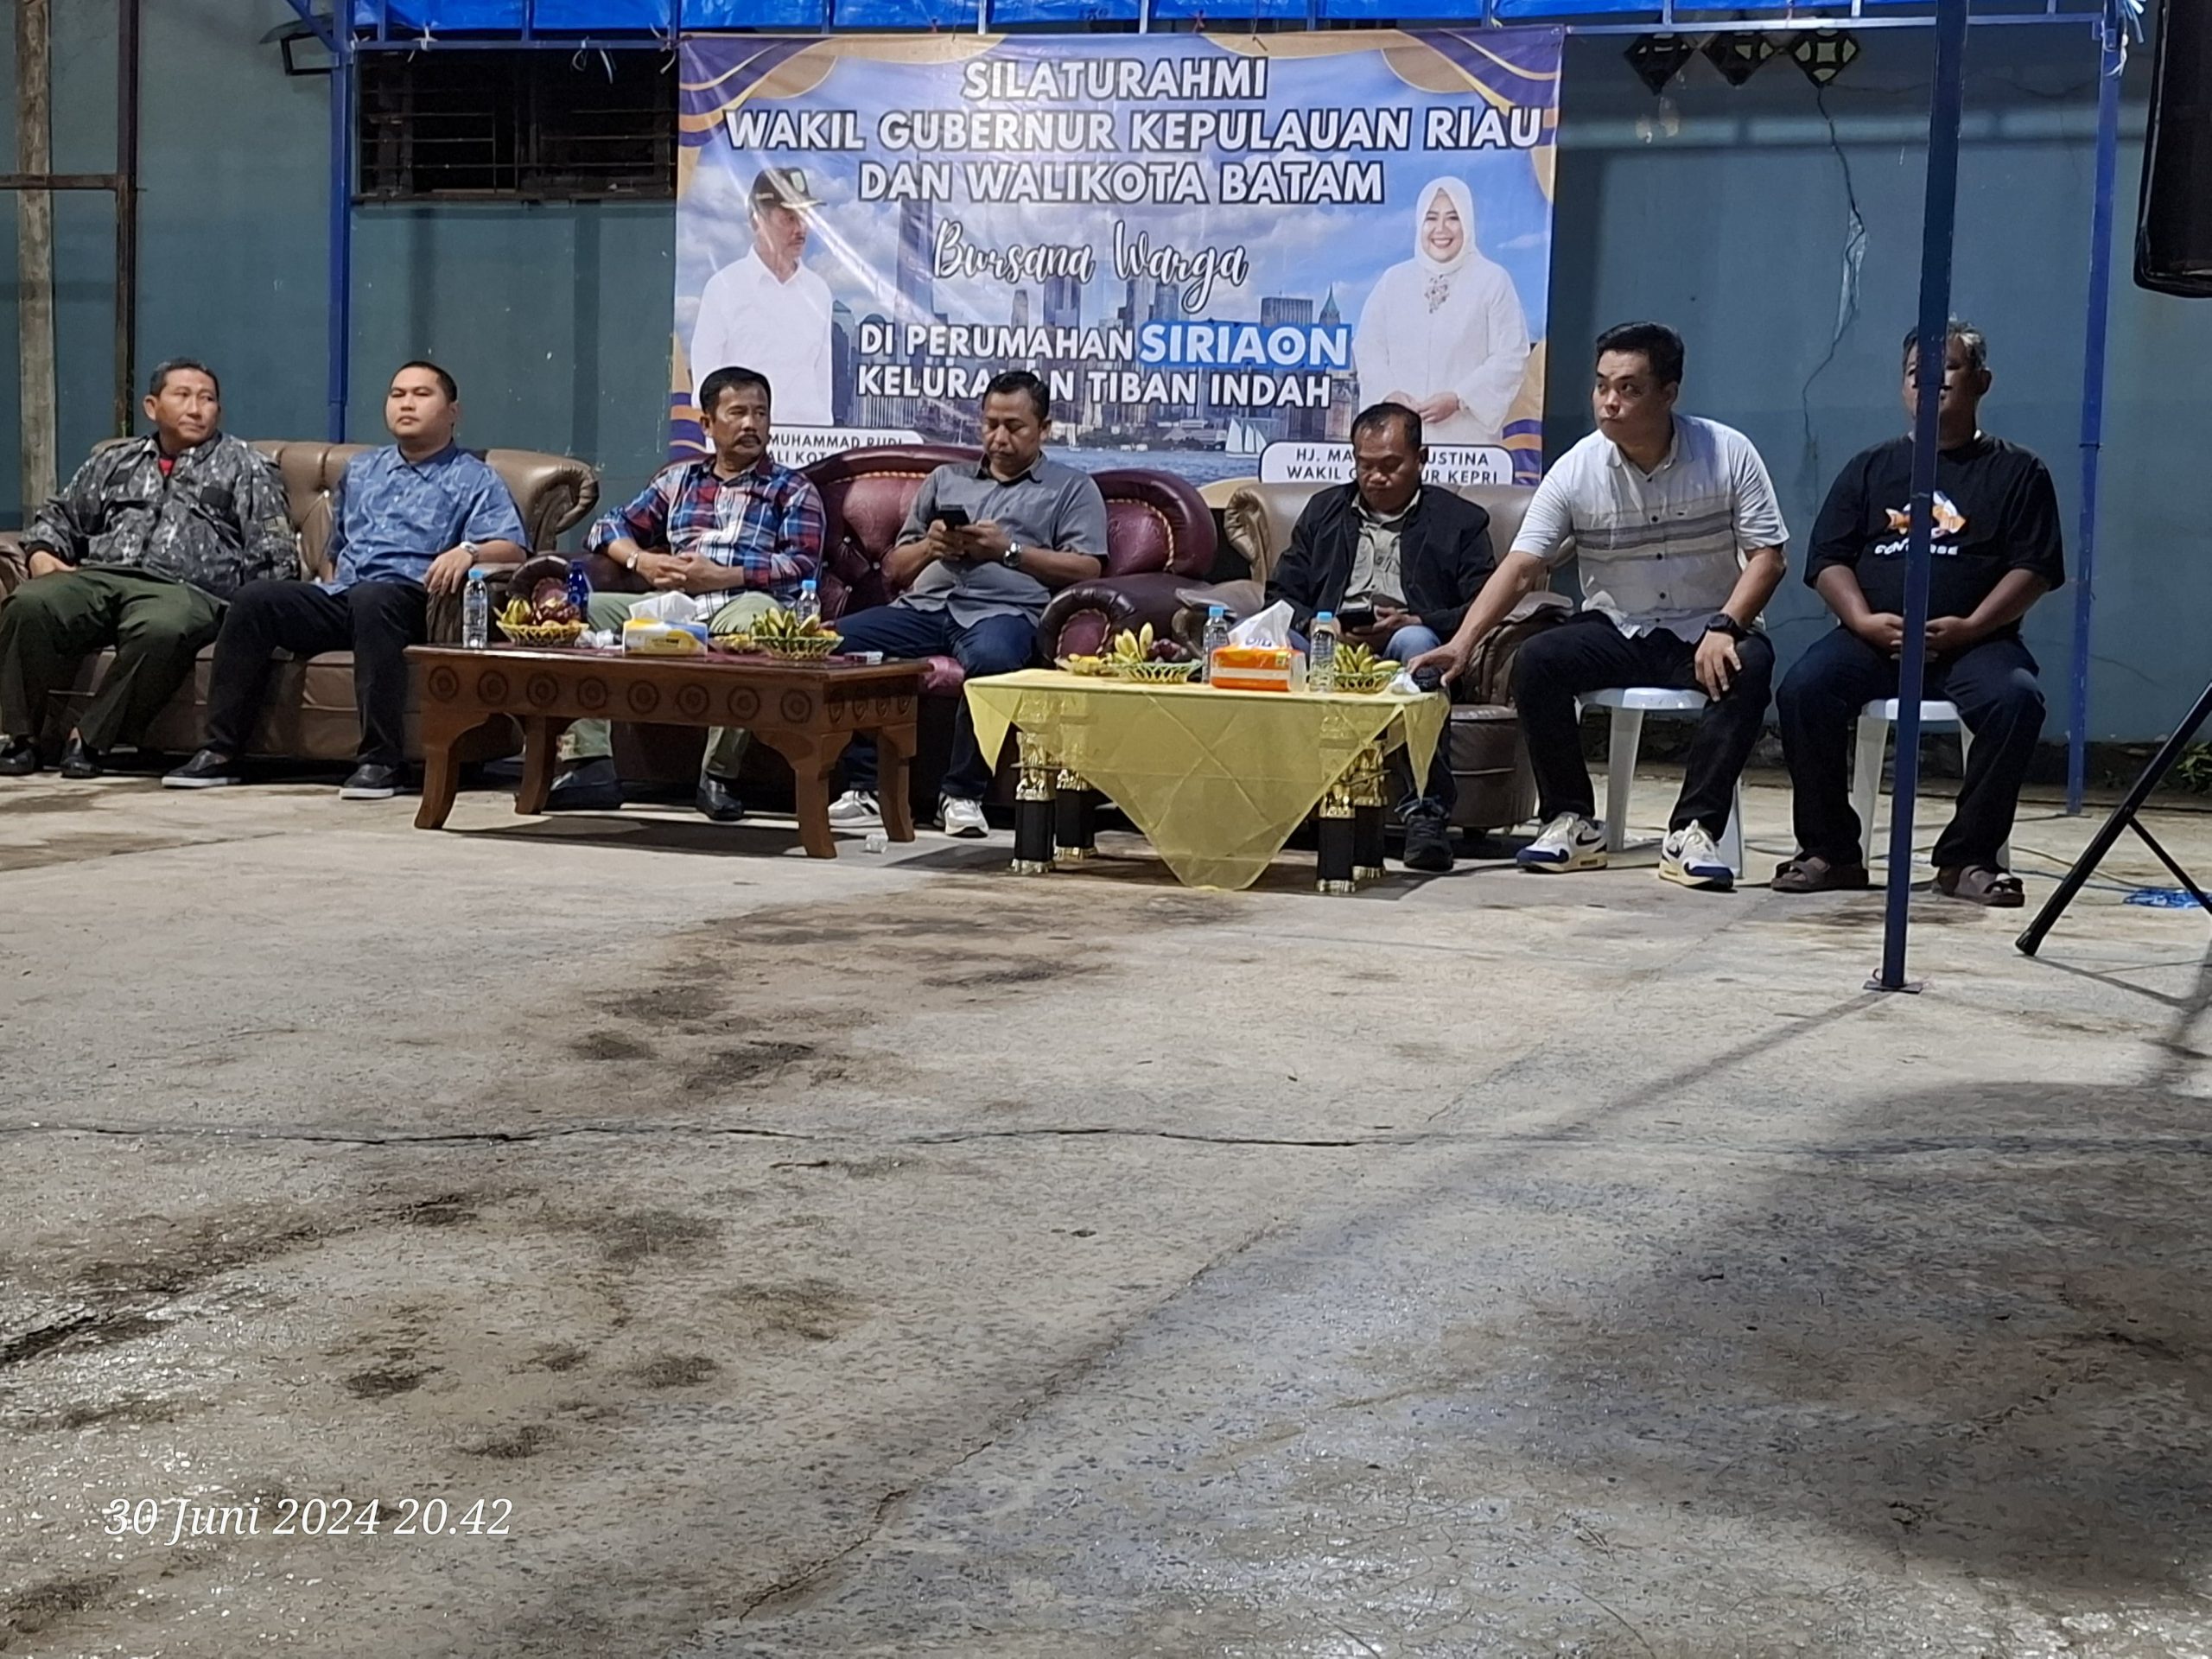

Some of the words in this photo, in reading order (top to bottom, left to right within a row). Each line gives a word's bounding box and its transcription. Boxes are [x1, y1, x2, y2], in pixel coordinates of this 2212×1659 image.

[963, 58, 1268, 100] SILATURAHMI
[724, 110, 866, 151] WAKIL
[878, 109, 1120, 152] GUBERNUR
[1128, 107, 1412, 151] KEPULAUAN
[1423, 105, 1543, 150] RIAU
[858, 160, 952, 202] DAN
[963, 160, 1210, 203] WALIKOTA
[1219, 161, 1384, 203] BATAM
[1113, 219, 1249, 315] Warga
[860, 323, 893, 356] DI
[906, 324, 1135, 362] PERUMAHAN
[1141, 322, 1349, 367] SIRIAON
[857, 364, 1076, 402] KELURAN
[1087, 370, 1198, 405] TIBAN
[1210, 372, 1332, 409] INDAH
[1287, 466, 1342, 480] WAKIL
[1447, 470, 1497, 485] KEPRI
[1296, 448, 1321, 462] HJ.
[1427, 451, 1489, 467] USTINA
